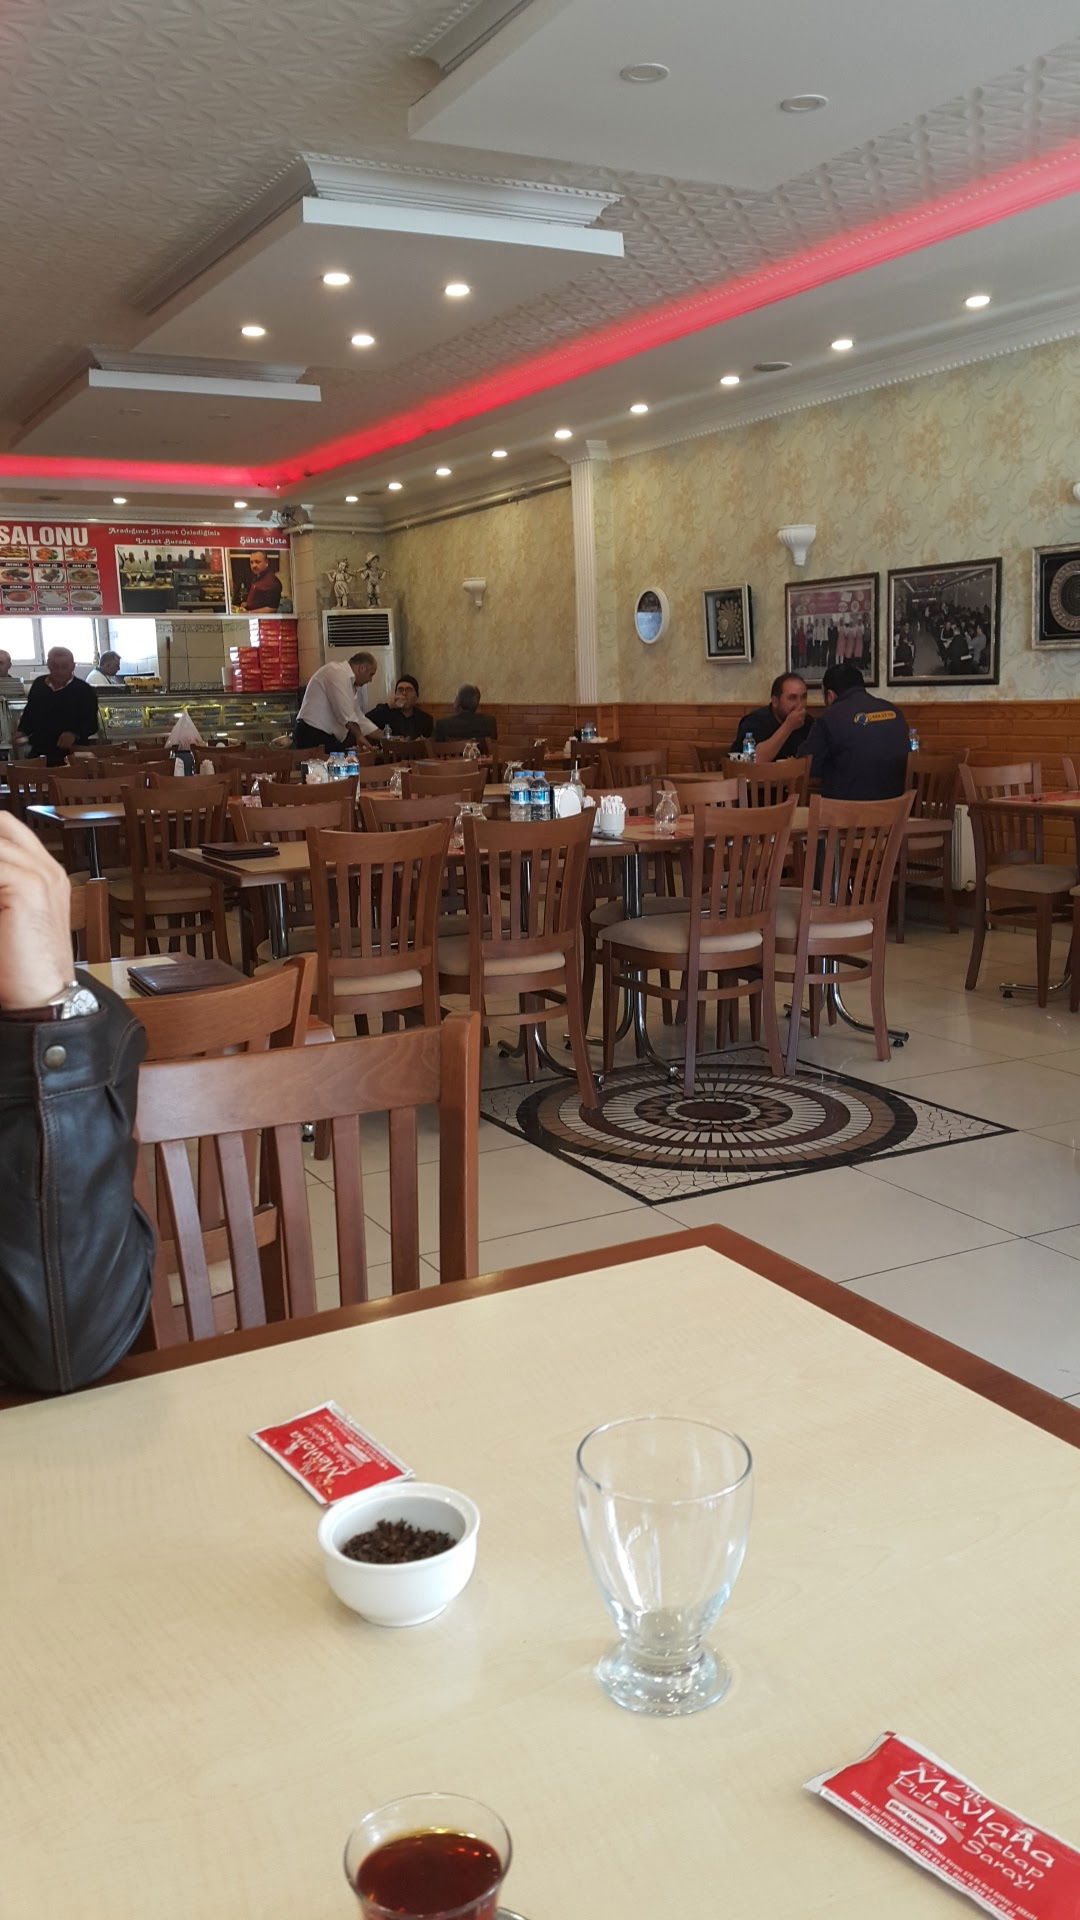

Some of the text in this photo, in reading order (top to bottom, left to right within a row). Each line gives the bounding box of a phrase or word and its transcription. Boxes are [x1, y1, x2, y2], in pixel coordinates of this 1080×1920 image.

[0, 526, 89, 546] SALONU
[894, 1776, 938, 1808] Pide
[945, 1811, 967, 1829] ve
[973, 1826, 1045, 1878] Kebap
[962, 1840, 1035, 1891] Sarayı
